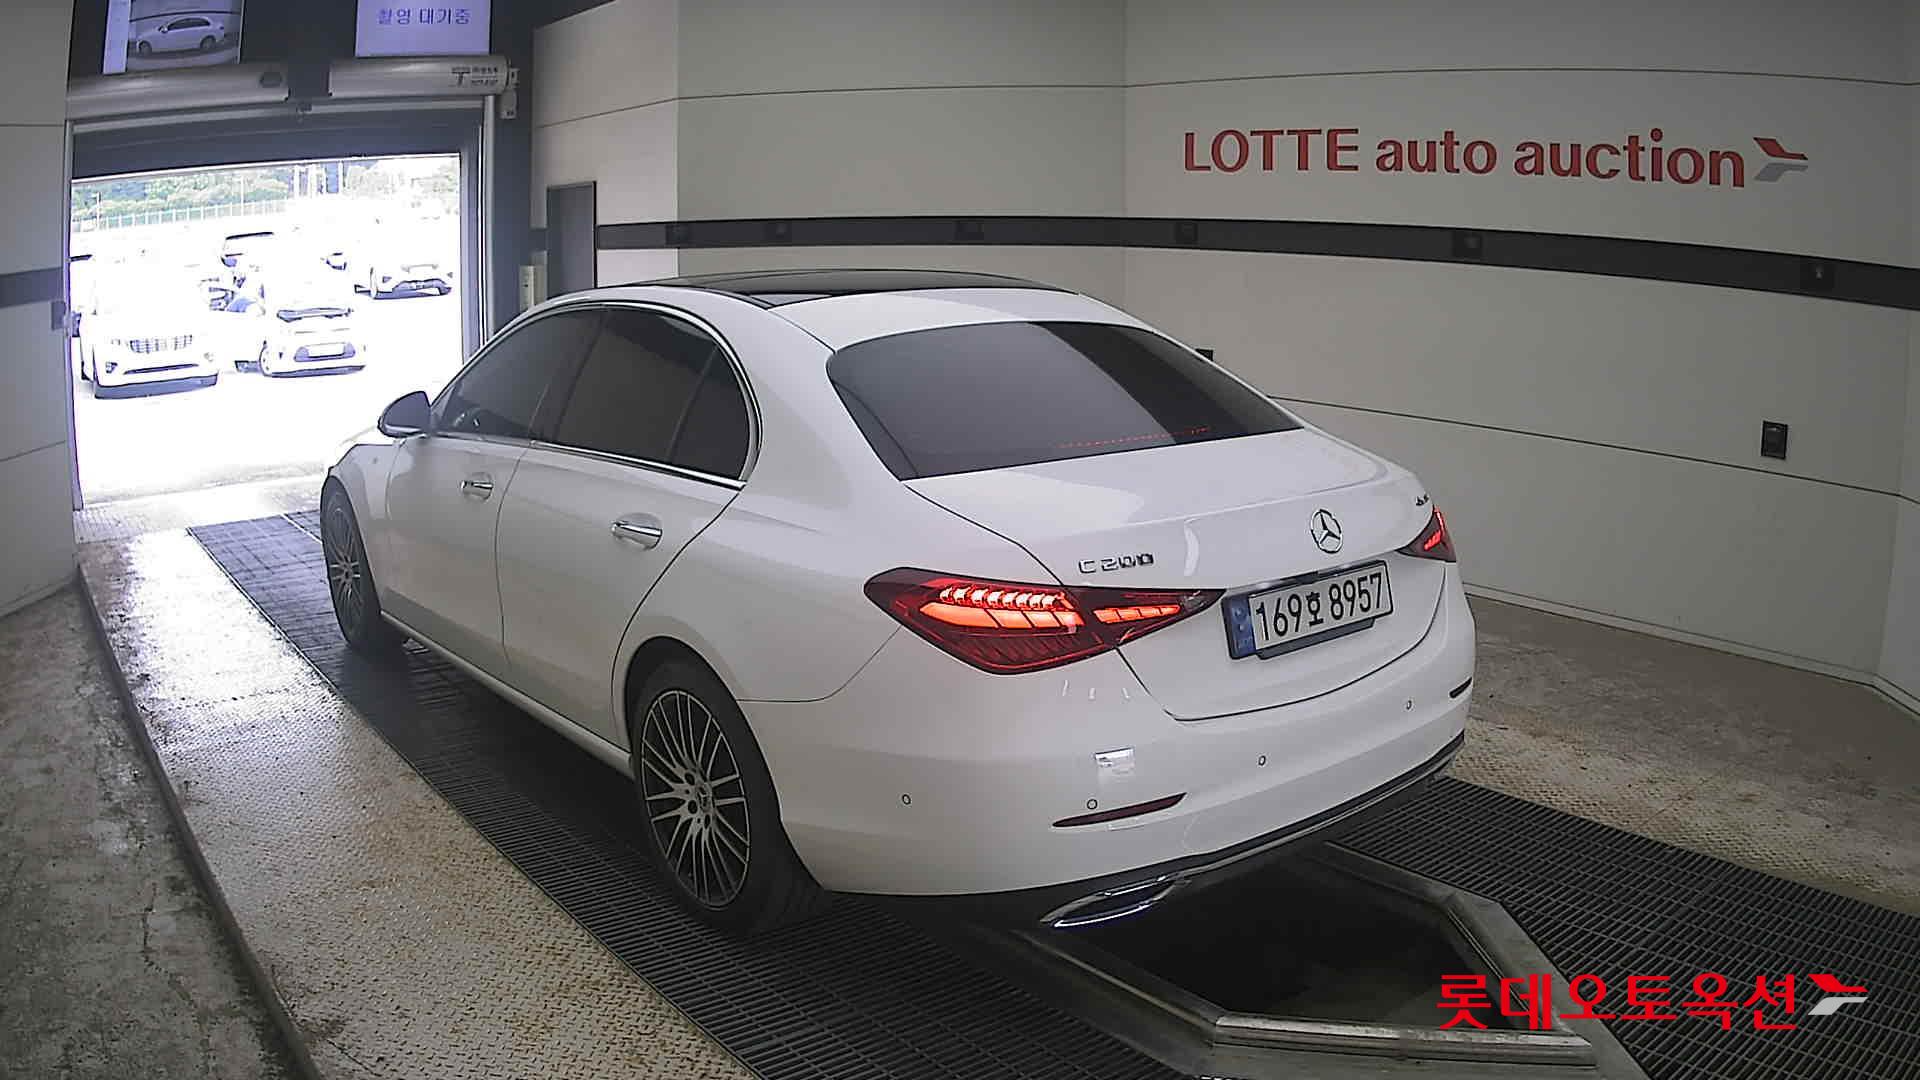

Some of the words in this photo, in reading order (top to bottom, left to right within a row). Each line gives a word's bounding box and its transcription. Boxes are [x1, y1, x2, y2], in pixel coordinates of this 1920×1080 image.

[419, 8, 471, 25] 대기중
[1184, 128, 1360, 173] LOTTE
[1374, 130, 1498, 175] auto
[1513, 128, 1745, 188] auction
[1078, 559, 1097, 574] C
[1101, 552, 1154, 572] 200
[1255, 591, 1324, 641] 169호
[1328, 572, 1382, 621] 8957
